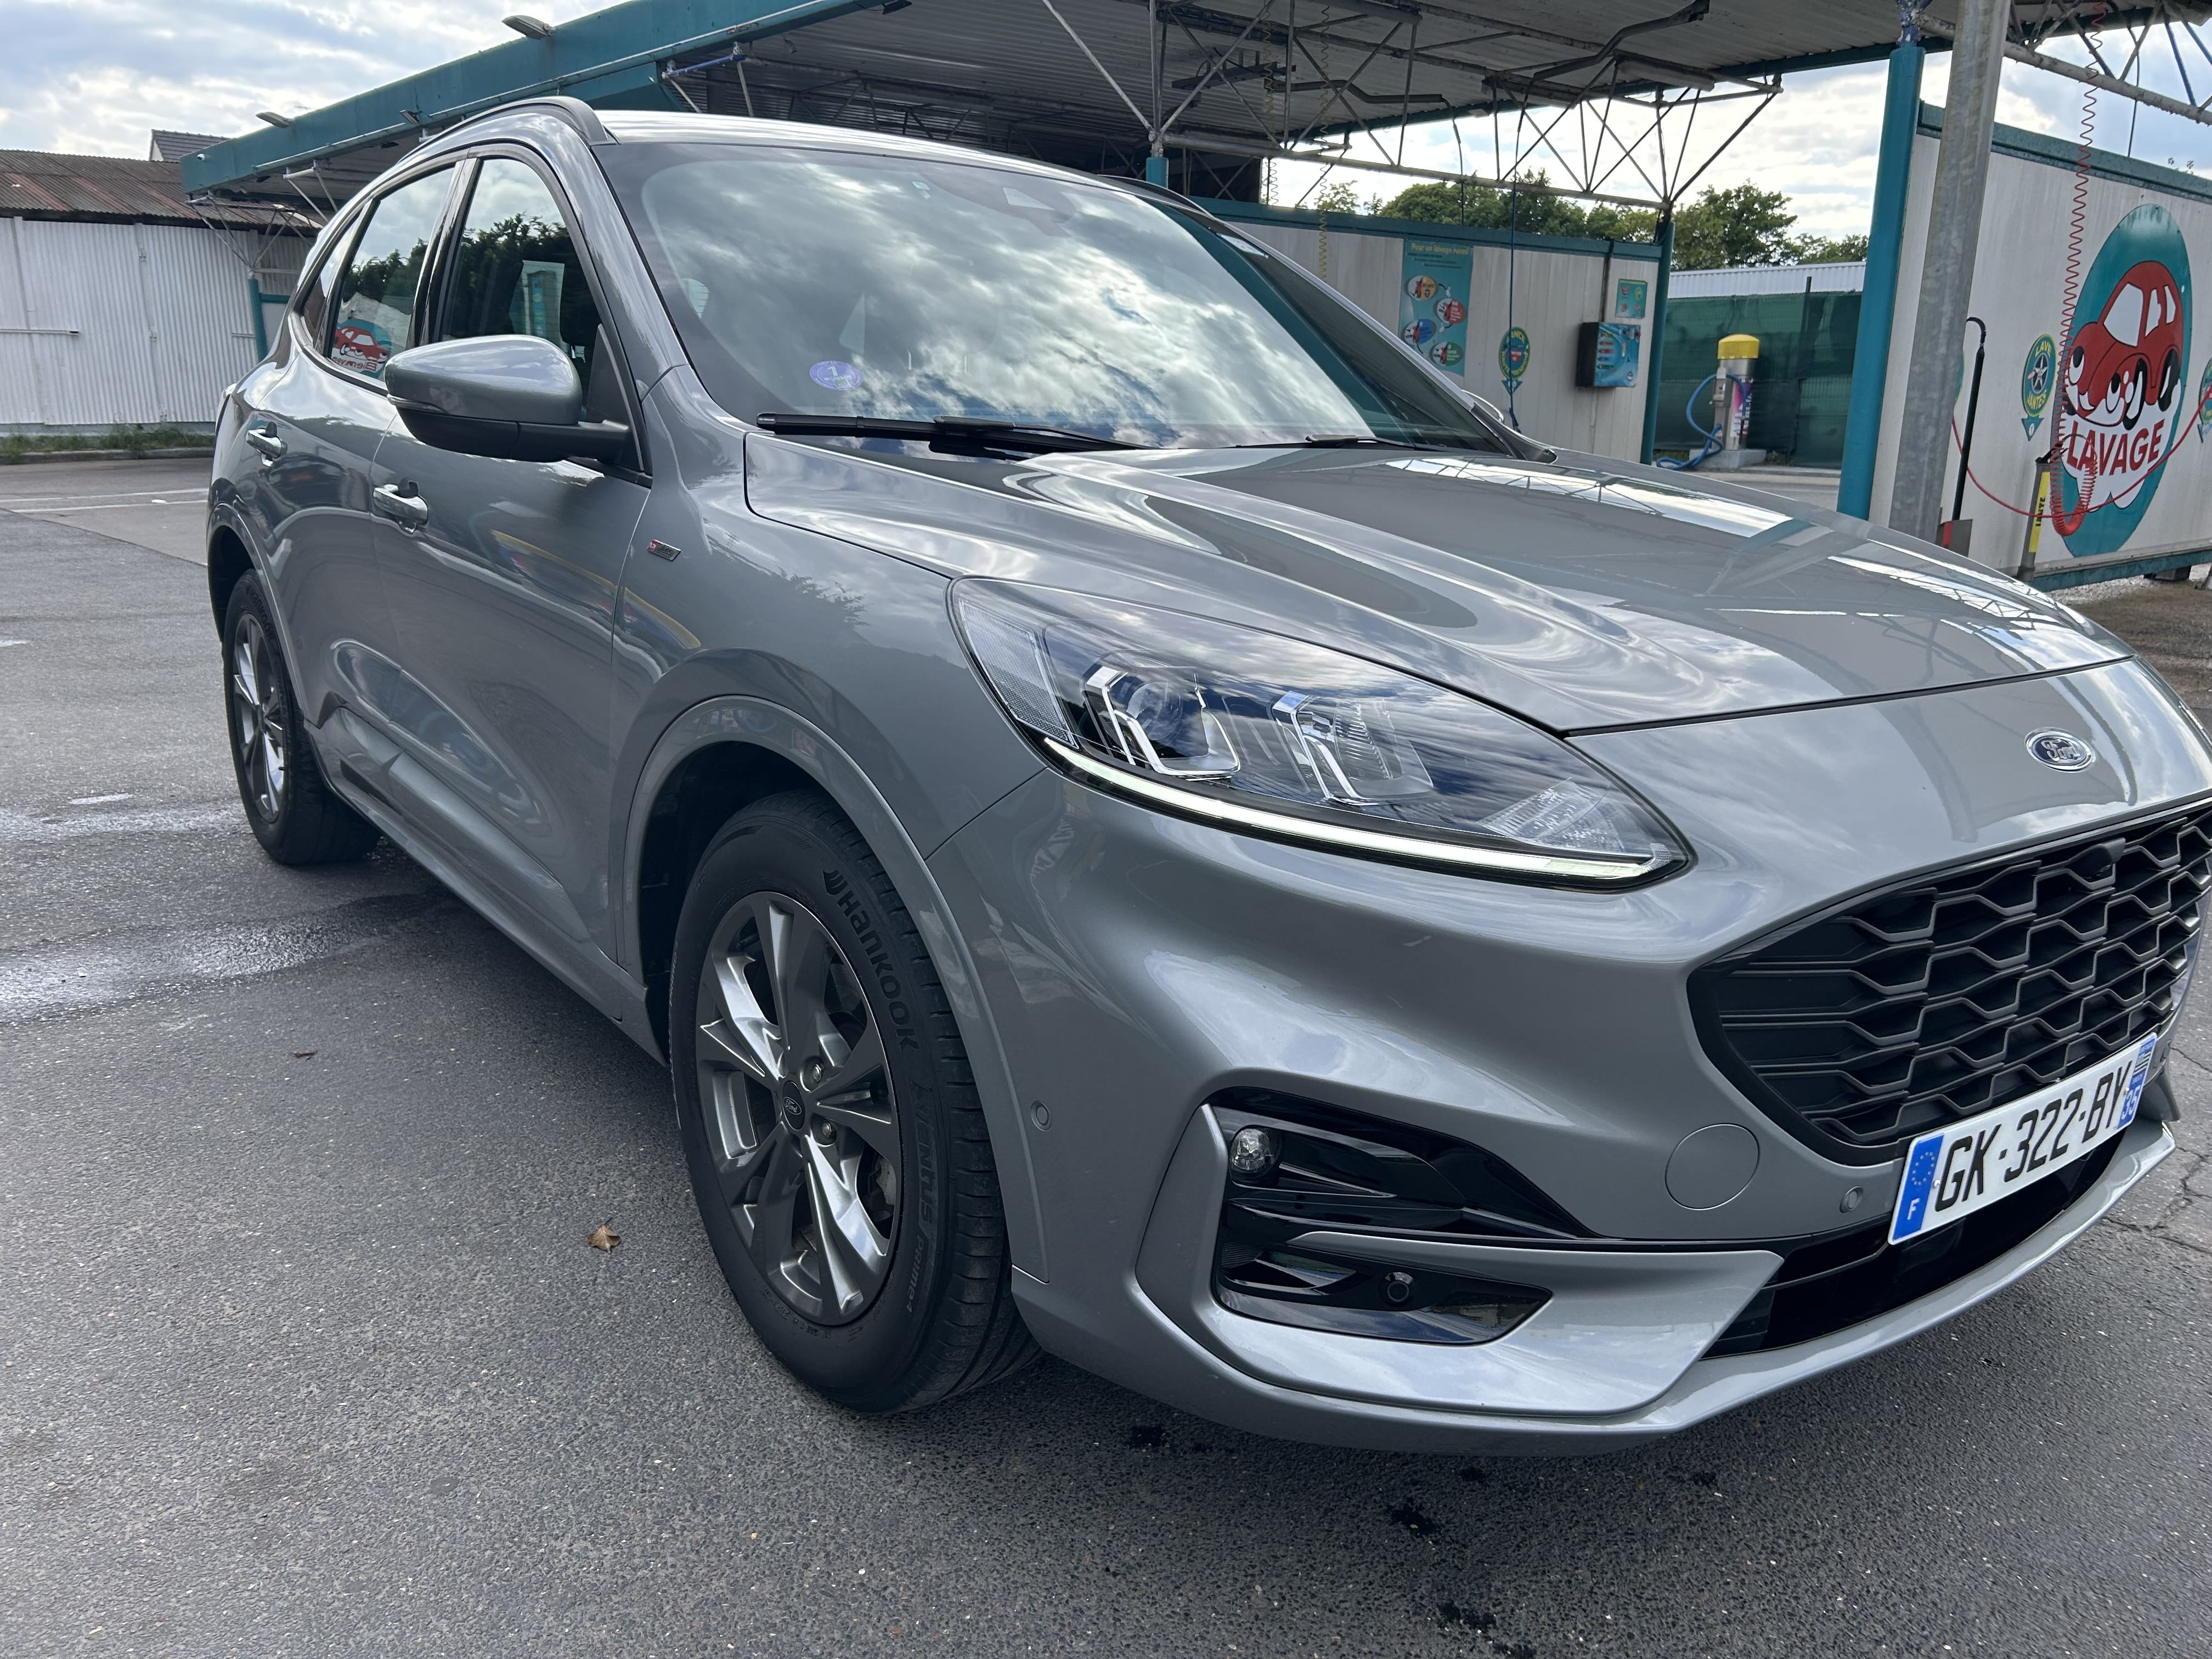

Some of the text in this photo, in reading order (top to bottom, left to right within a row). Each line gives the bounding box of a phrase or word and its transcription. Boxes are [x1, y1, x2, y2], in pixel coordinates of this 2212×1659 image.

[2035, 340, 2051, 358] LAVE
[2027, 389, 2047, 410] JANTES
[2067, 419, 2165, 476] LAVAGE
[2041, 739, 2081, 761] Ford
[2121, 1085, 2141, 1120] 35
[1934, 1060, 2132, 1213] GK-322-BY
[1906, 1199, 1920, 1221] F
